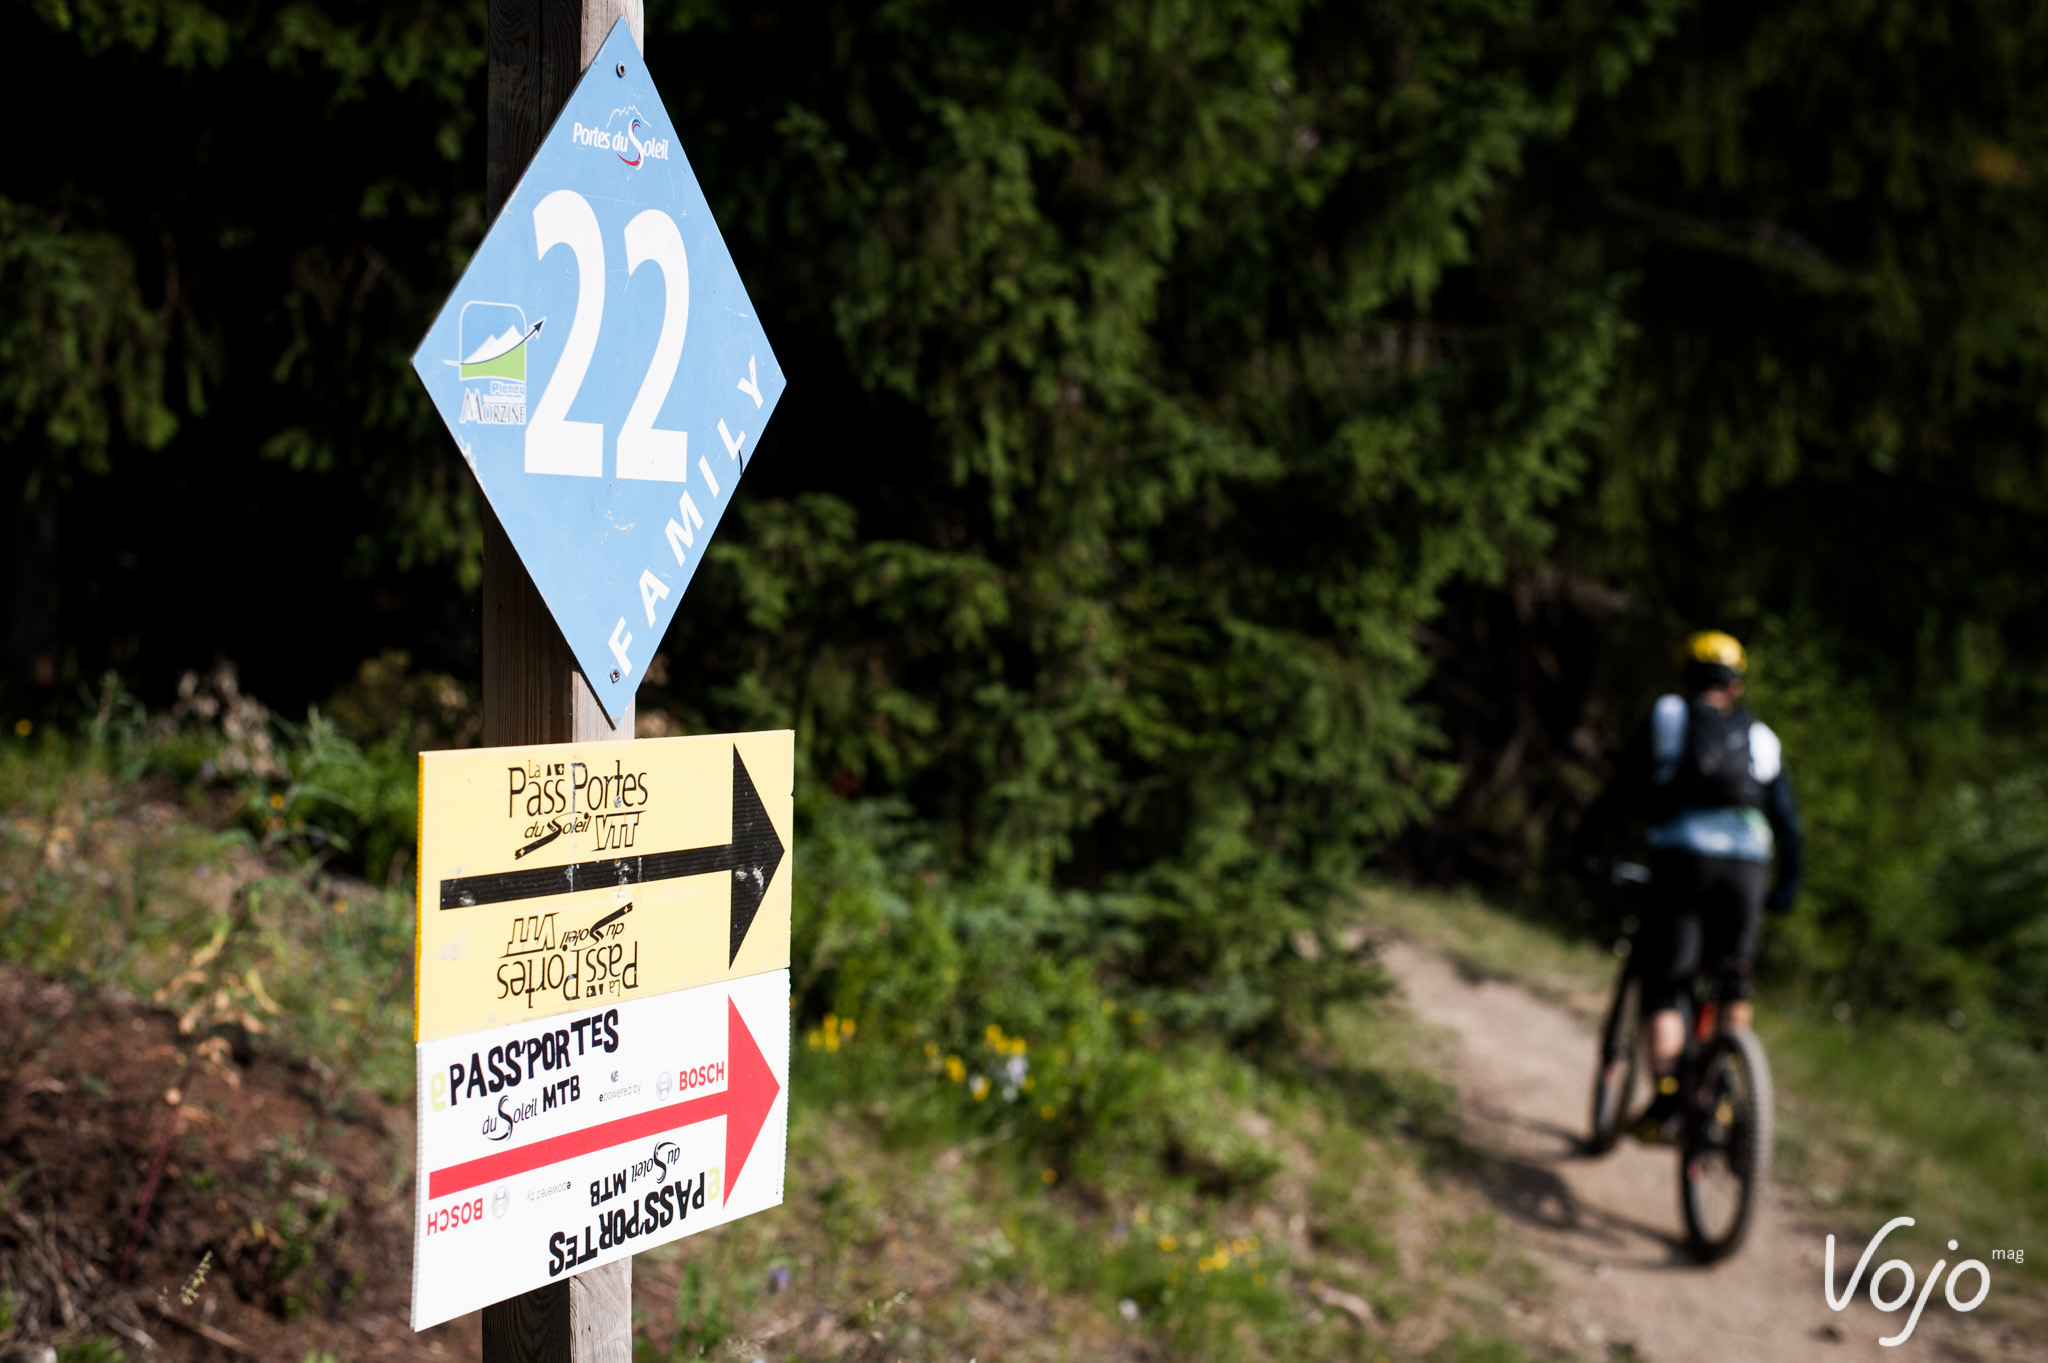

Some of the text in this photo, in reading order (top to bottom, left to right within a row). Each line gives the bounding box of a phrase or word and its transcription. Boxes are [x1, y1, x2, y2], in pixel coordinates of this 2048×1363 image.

[572, 117, 669, 170] Portes du Soleil
[524, 189, 689, 483] 22
[608, 354, 764, 677] FAMILY
[527, 759, 541, 778] La
[514, 810, 647, 860] du Soleil VTT
[498, 902, 633, 959] du Soleil VTT
[679, 1061, 725, 1091] BOSCH
[482, 1075, 580, 1142] du Soleil MTB
[590, 1141, 681, 1207] du Soleil MTB
[427, 1197, 483, 1236] BOSCH
